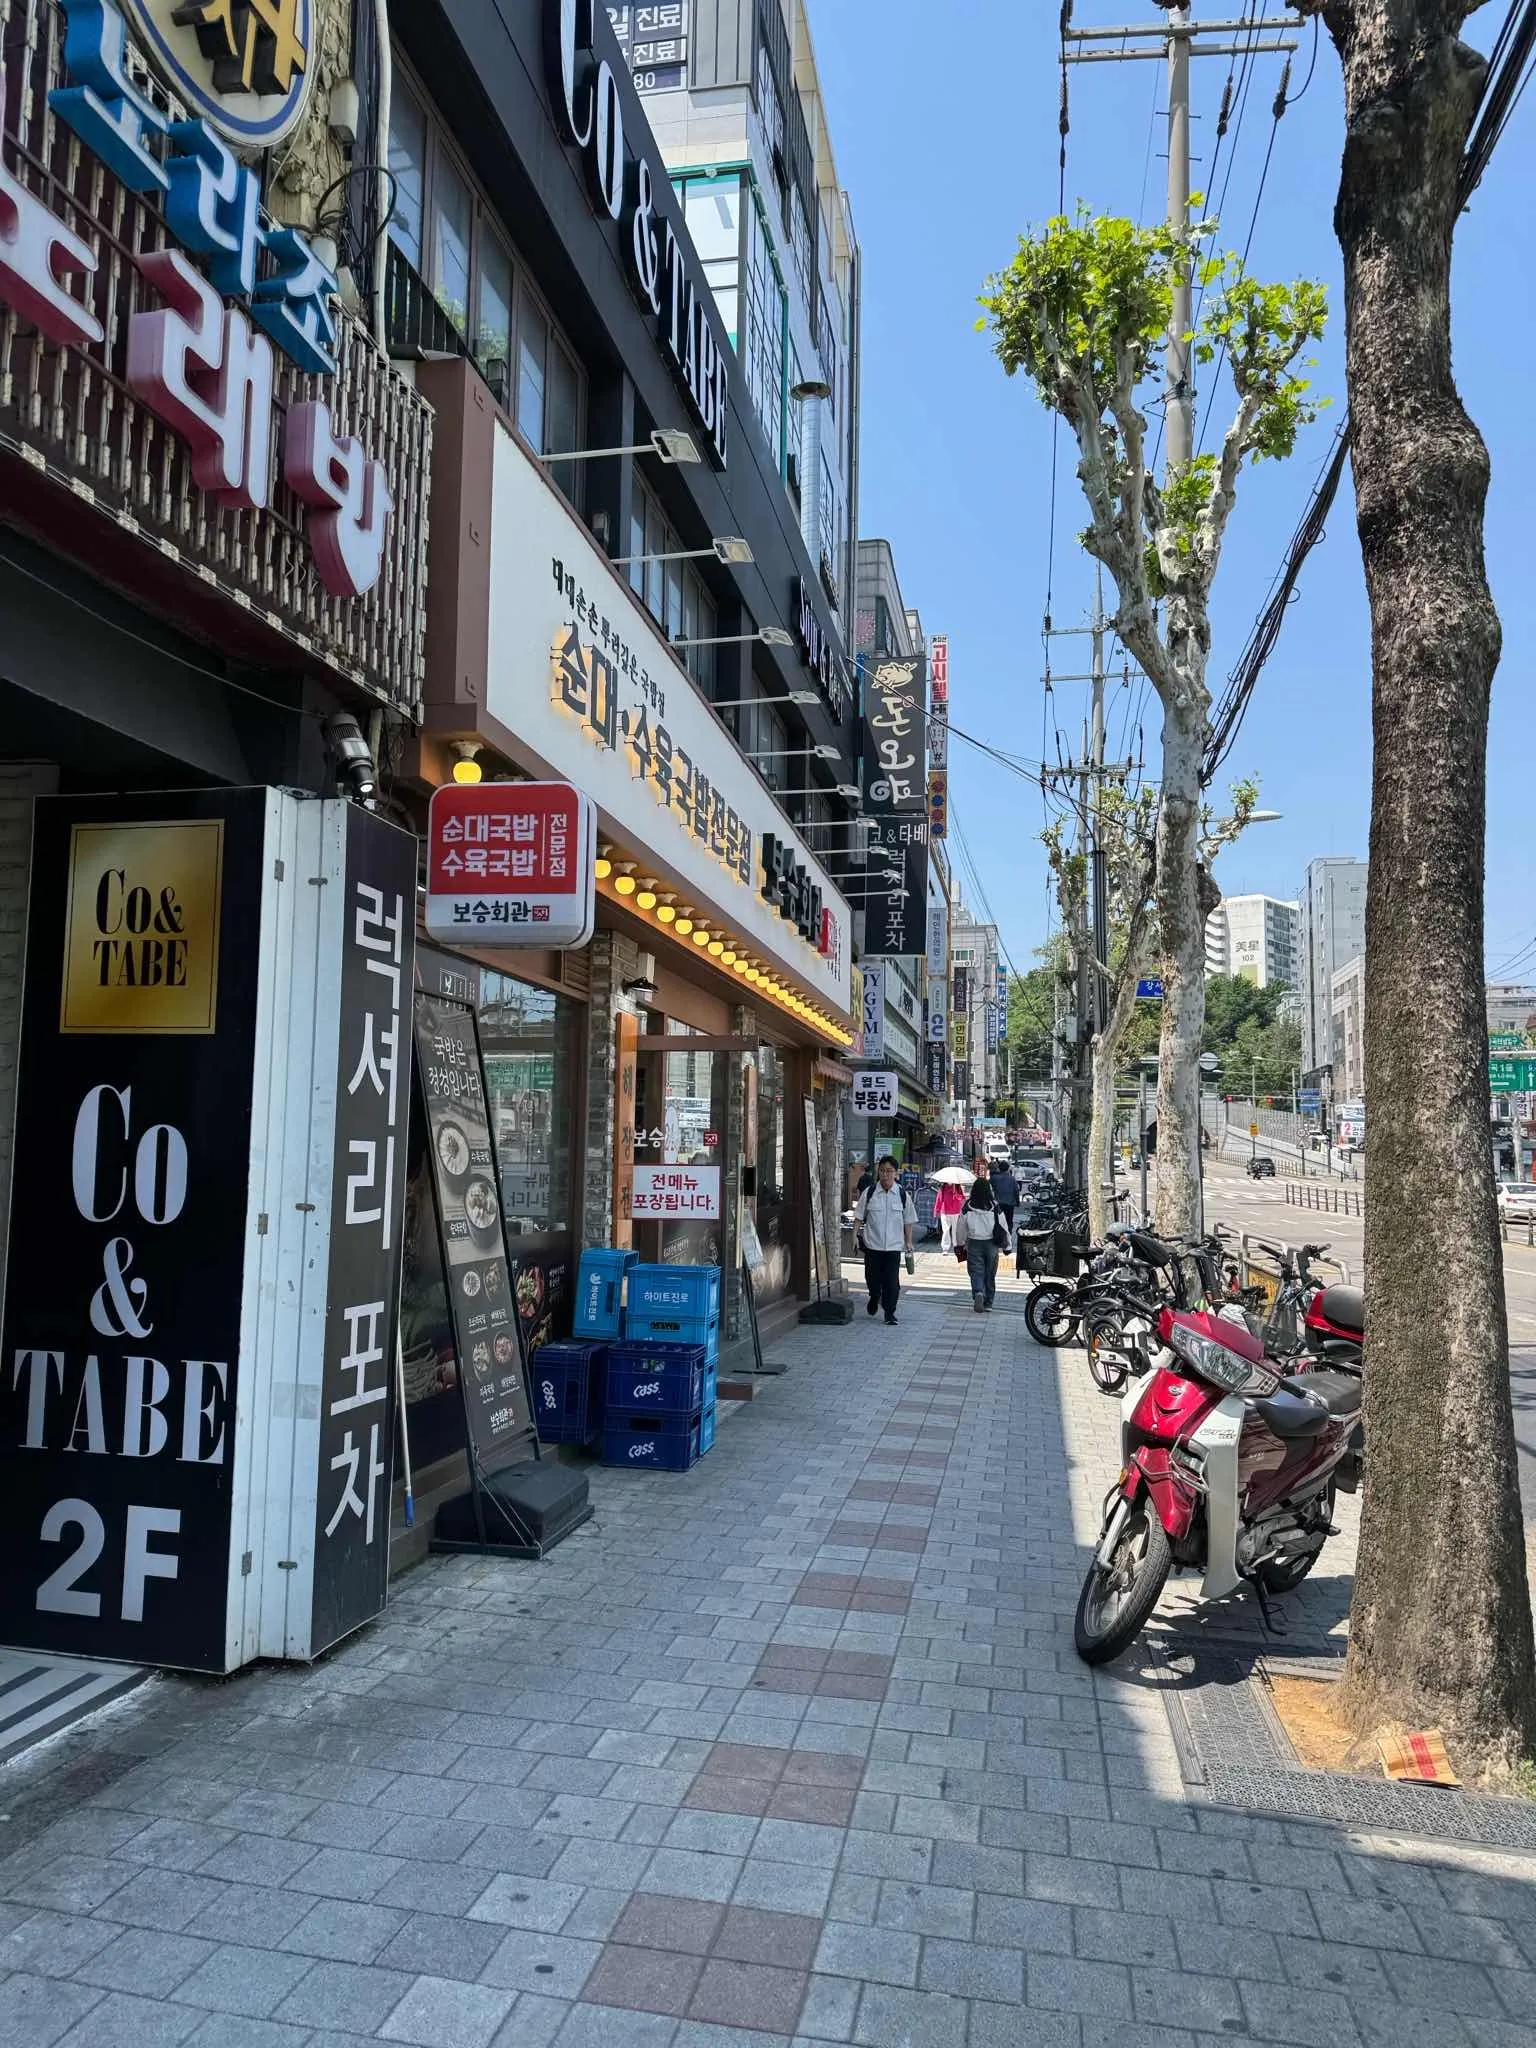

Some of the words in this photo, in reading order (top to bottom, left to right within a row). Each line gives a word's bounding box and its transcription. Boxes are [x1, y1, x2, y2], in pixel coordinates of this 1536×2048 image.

[637, 4, 680, 31] 진료
[634, 41, 676, 64] 진료
[662, 217, 727, 471] TABE
[641, 669, 665, 718] 국밥집
[442, 813, 538, 842] 순대국밥
[887, 829, 896, 843] &
[899, 824, 927, 846] 타베
[550, 813, 567, 877] 전문점
[441, 848, 537, 877] 수육국밥
[453, 900, 531, 923] 보승회관
[93, 939, 188, 986] TABE
[864, 992, 878, 1034] GYM
[931, 1014, 943, 1036] CU
[435, 1036, 466, 1065] 국밥은
[345, 883, 402, 1251] 럭셔리
[428, 1066, 480, 1097] 정성입니다
[861, 1076, 886, 1088] 월드
[855, 1091, 892, 1110] 부동산
[633, 1194, 715, 1211] 포장됩니다.
[90, 1237, 153, 1339] &
[644, 1291, 689, 1303] 하이트진로
[15, 1350, 227, 1465] TABE
[325, 1302, 387, 1544] 포차
[35, 1498, 181, 1621] 2F
